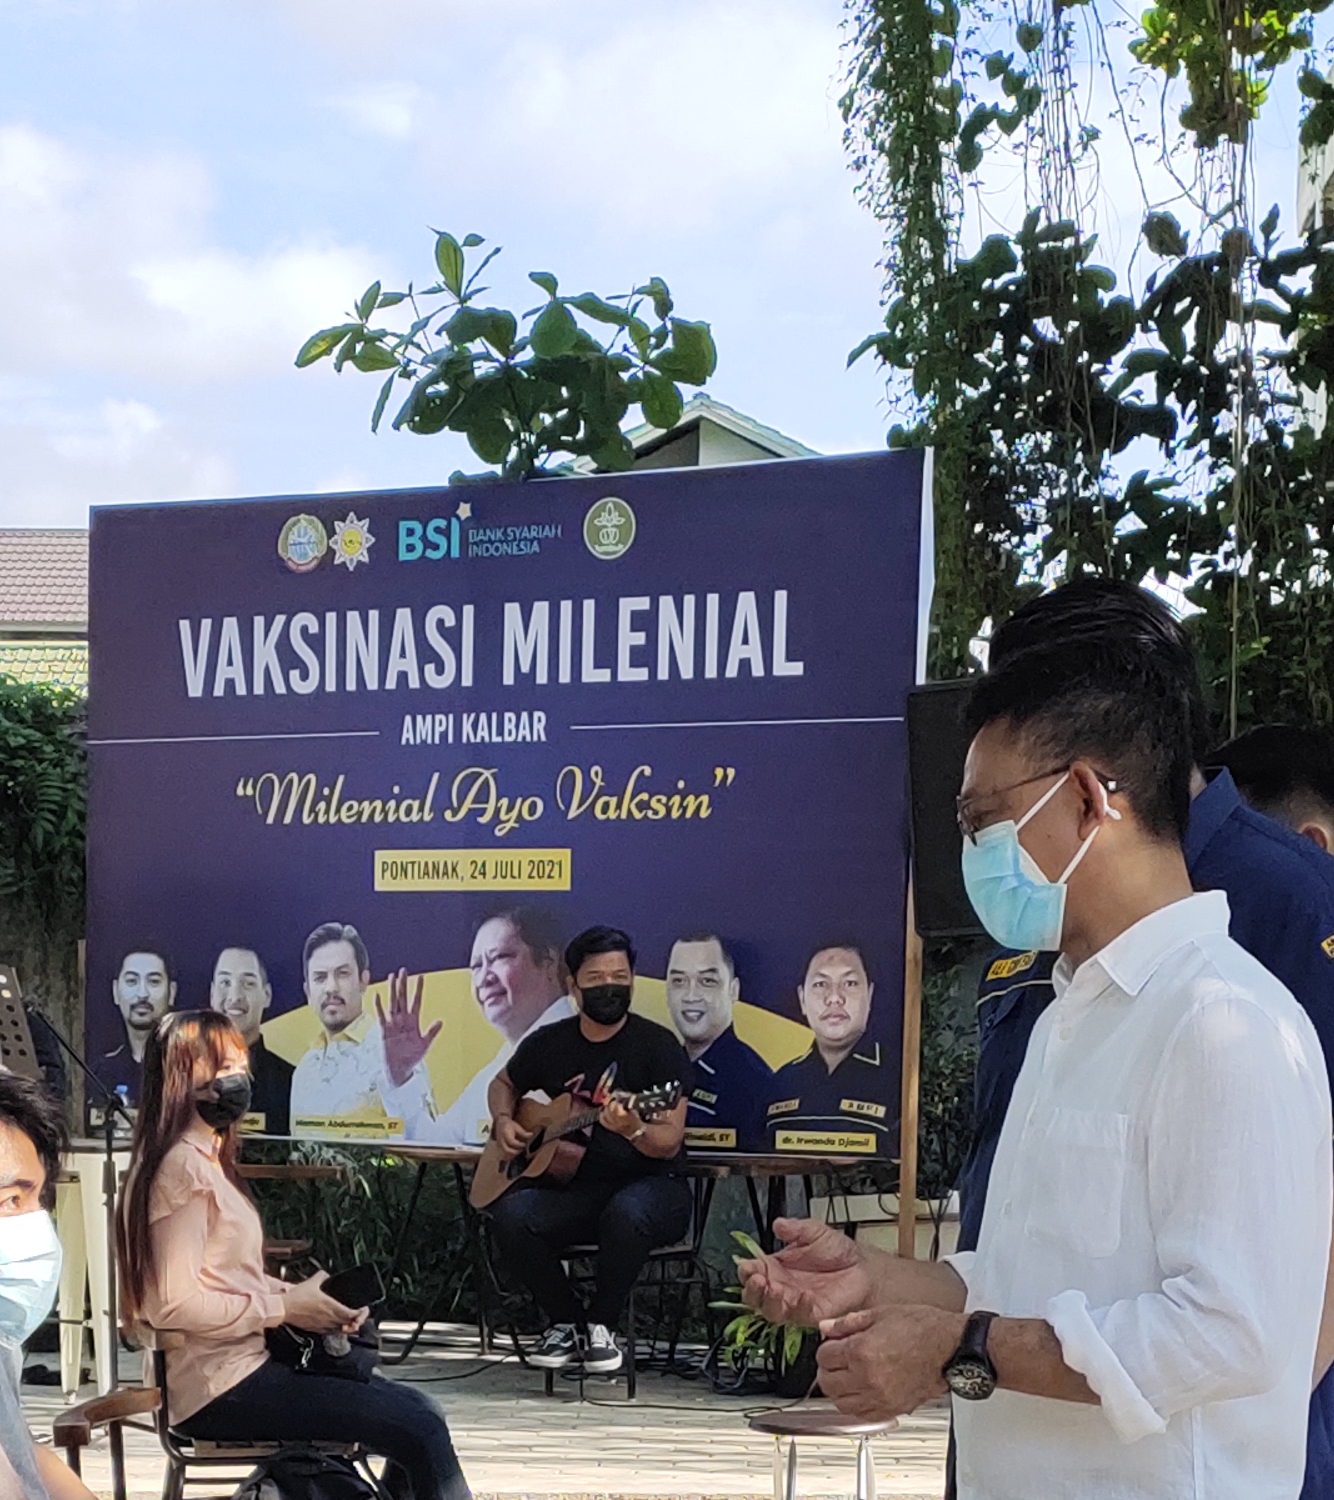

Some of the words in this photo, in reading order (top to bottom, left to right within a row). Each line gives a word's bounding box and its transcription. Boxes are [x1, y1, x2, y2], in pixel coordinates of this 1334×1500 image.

[398, 517, 461, 561] BSI
[468, 540, 540, 558] INDONESIA
[507, 523, 562, 541] SYARIAH
[178, 604, 475, 698] VAKSINASI
[503, 589, 805, 686] MILENIAL
[401, 713, 454, 746] AMPI
[462, 710, 547, 744] KALBAR
[444, 766, 545, 837] Ayo
[380, 859, 465, 883] PONTIANAK,
[469, 860, 488, 881] 24
[492, 859, 522, 881] JULI
[527, 858, 564, 880] 2021
